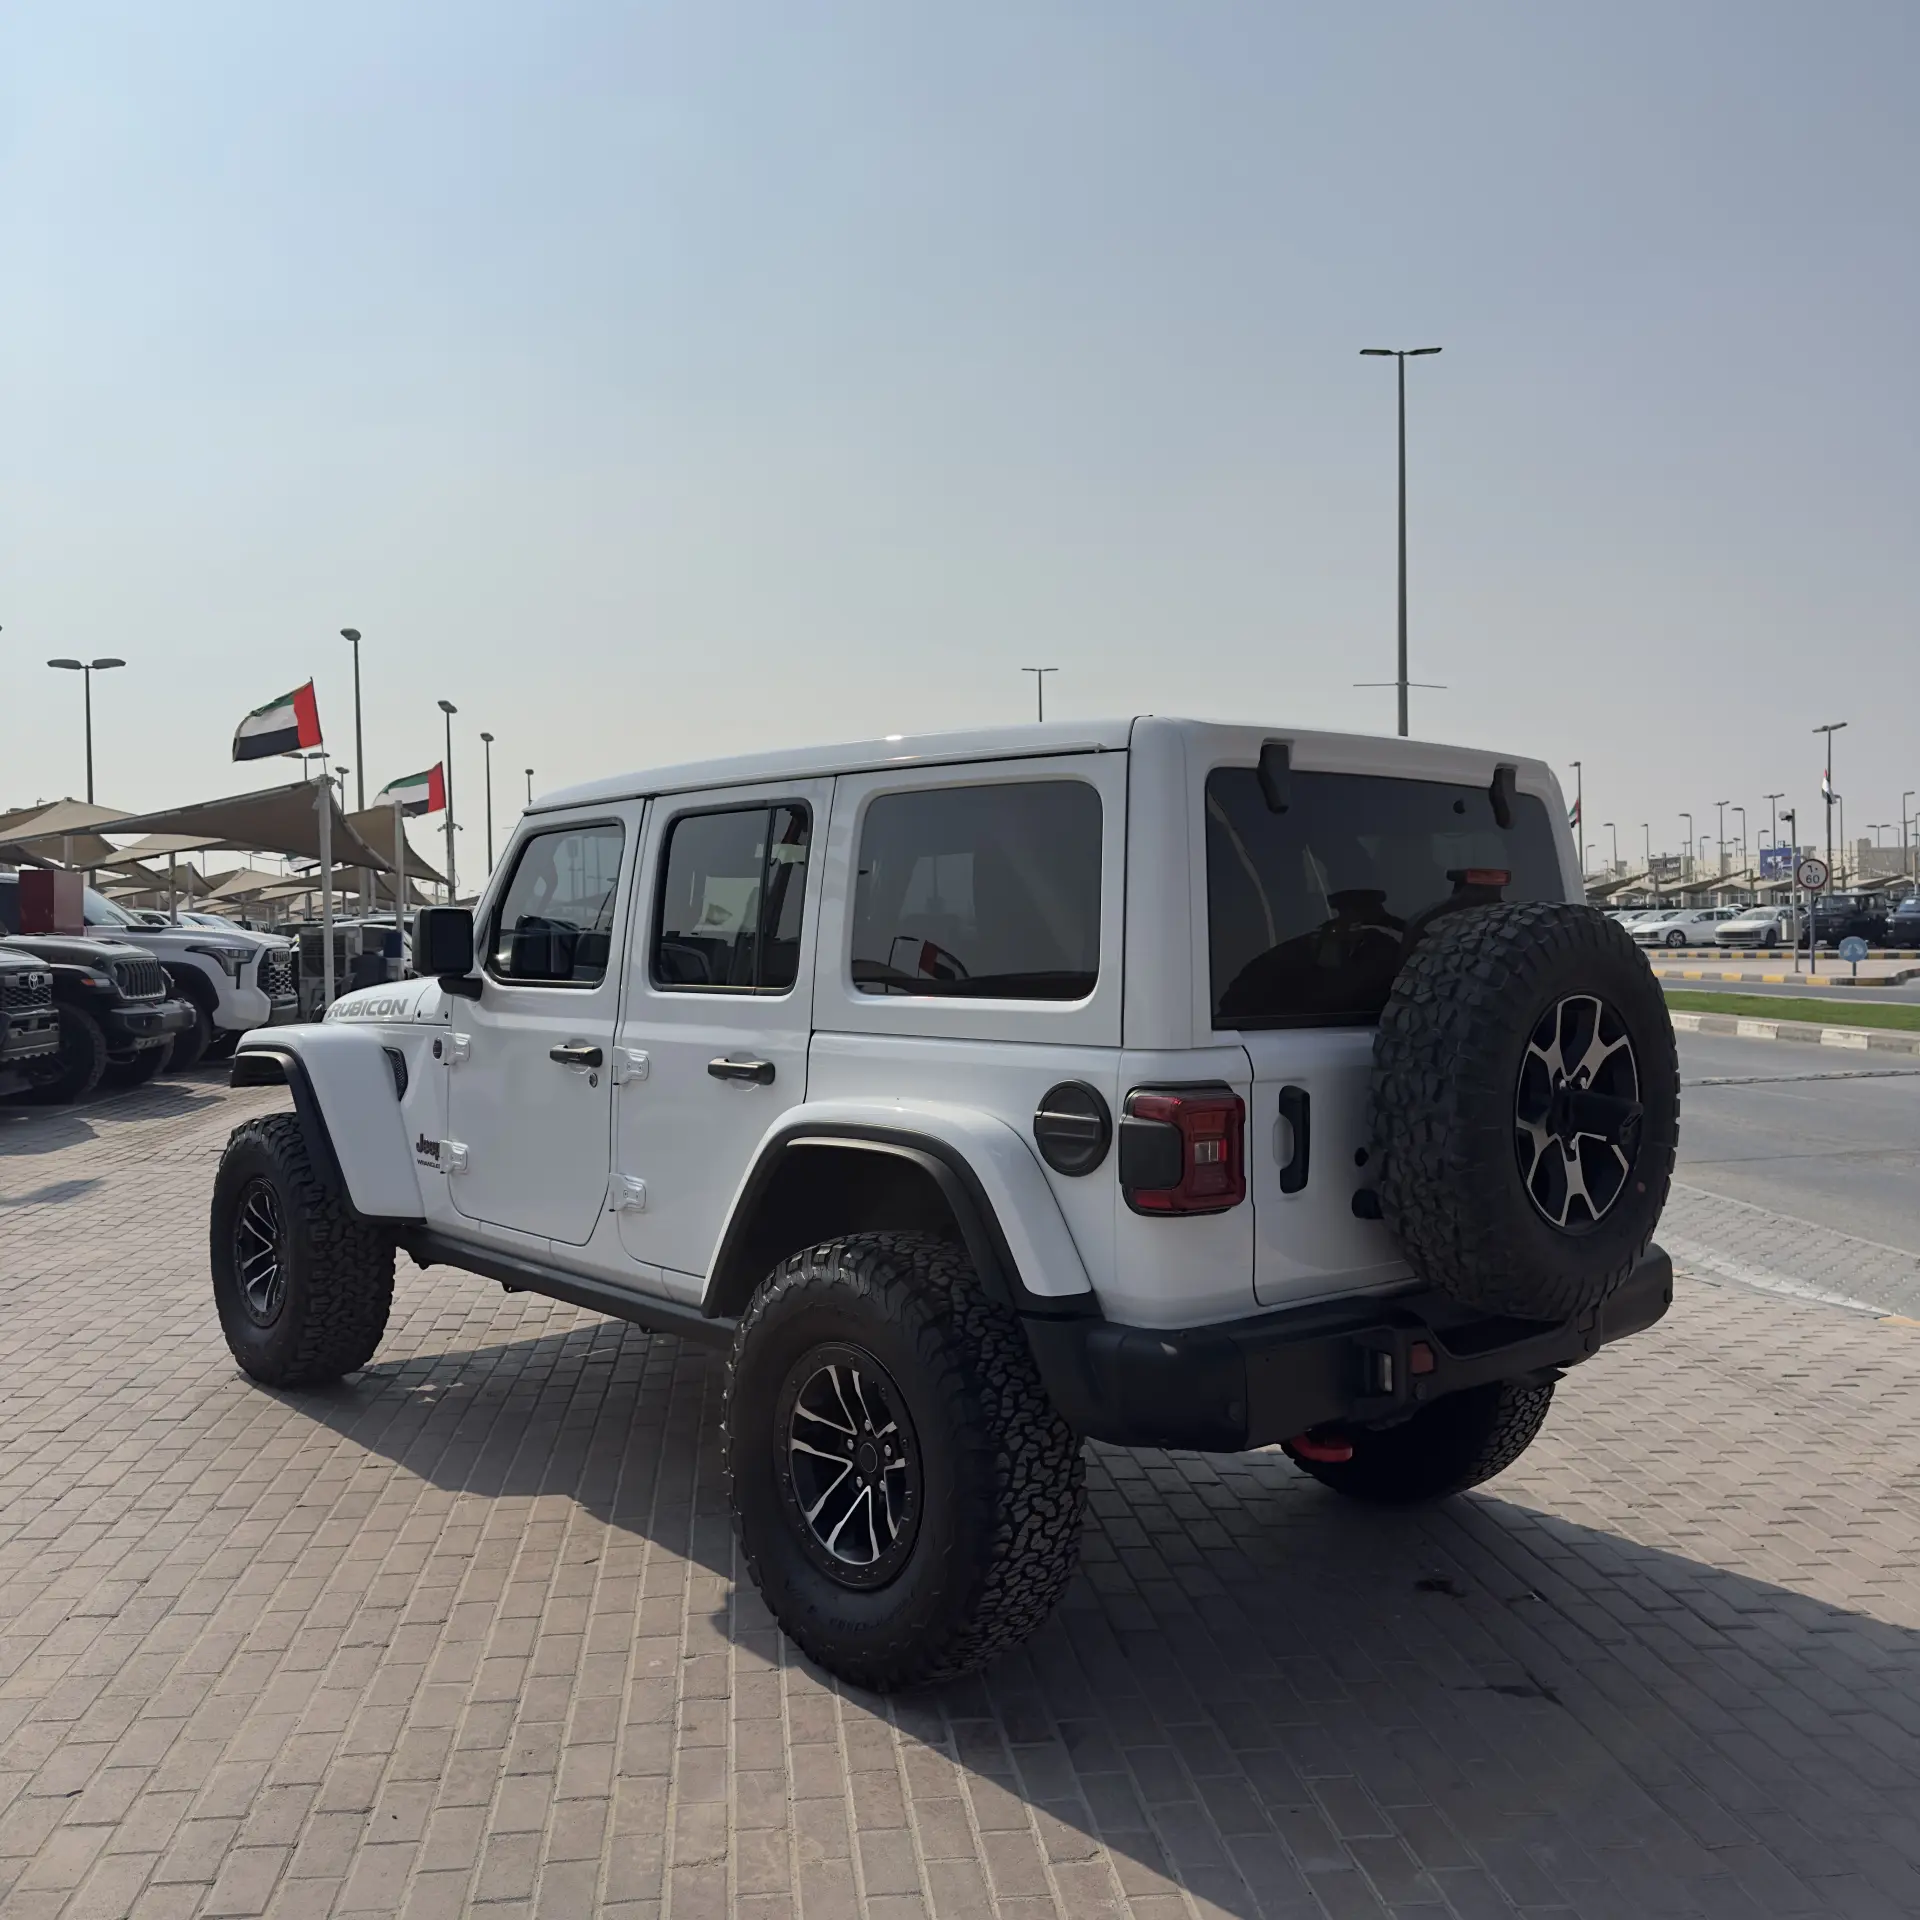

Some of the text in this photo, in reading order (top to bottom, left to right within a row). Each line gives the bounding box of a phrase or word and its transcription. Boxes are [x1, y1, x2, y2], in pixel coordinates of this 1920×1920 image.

[1807, 865, 1818, 873] ٦٠
[1806, 875, 1820, 884] 60
[327, 998, 409, 1018] RUBICON
